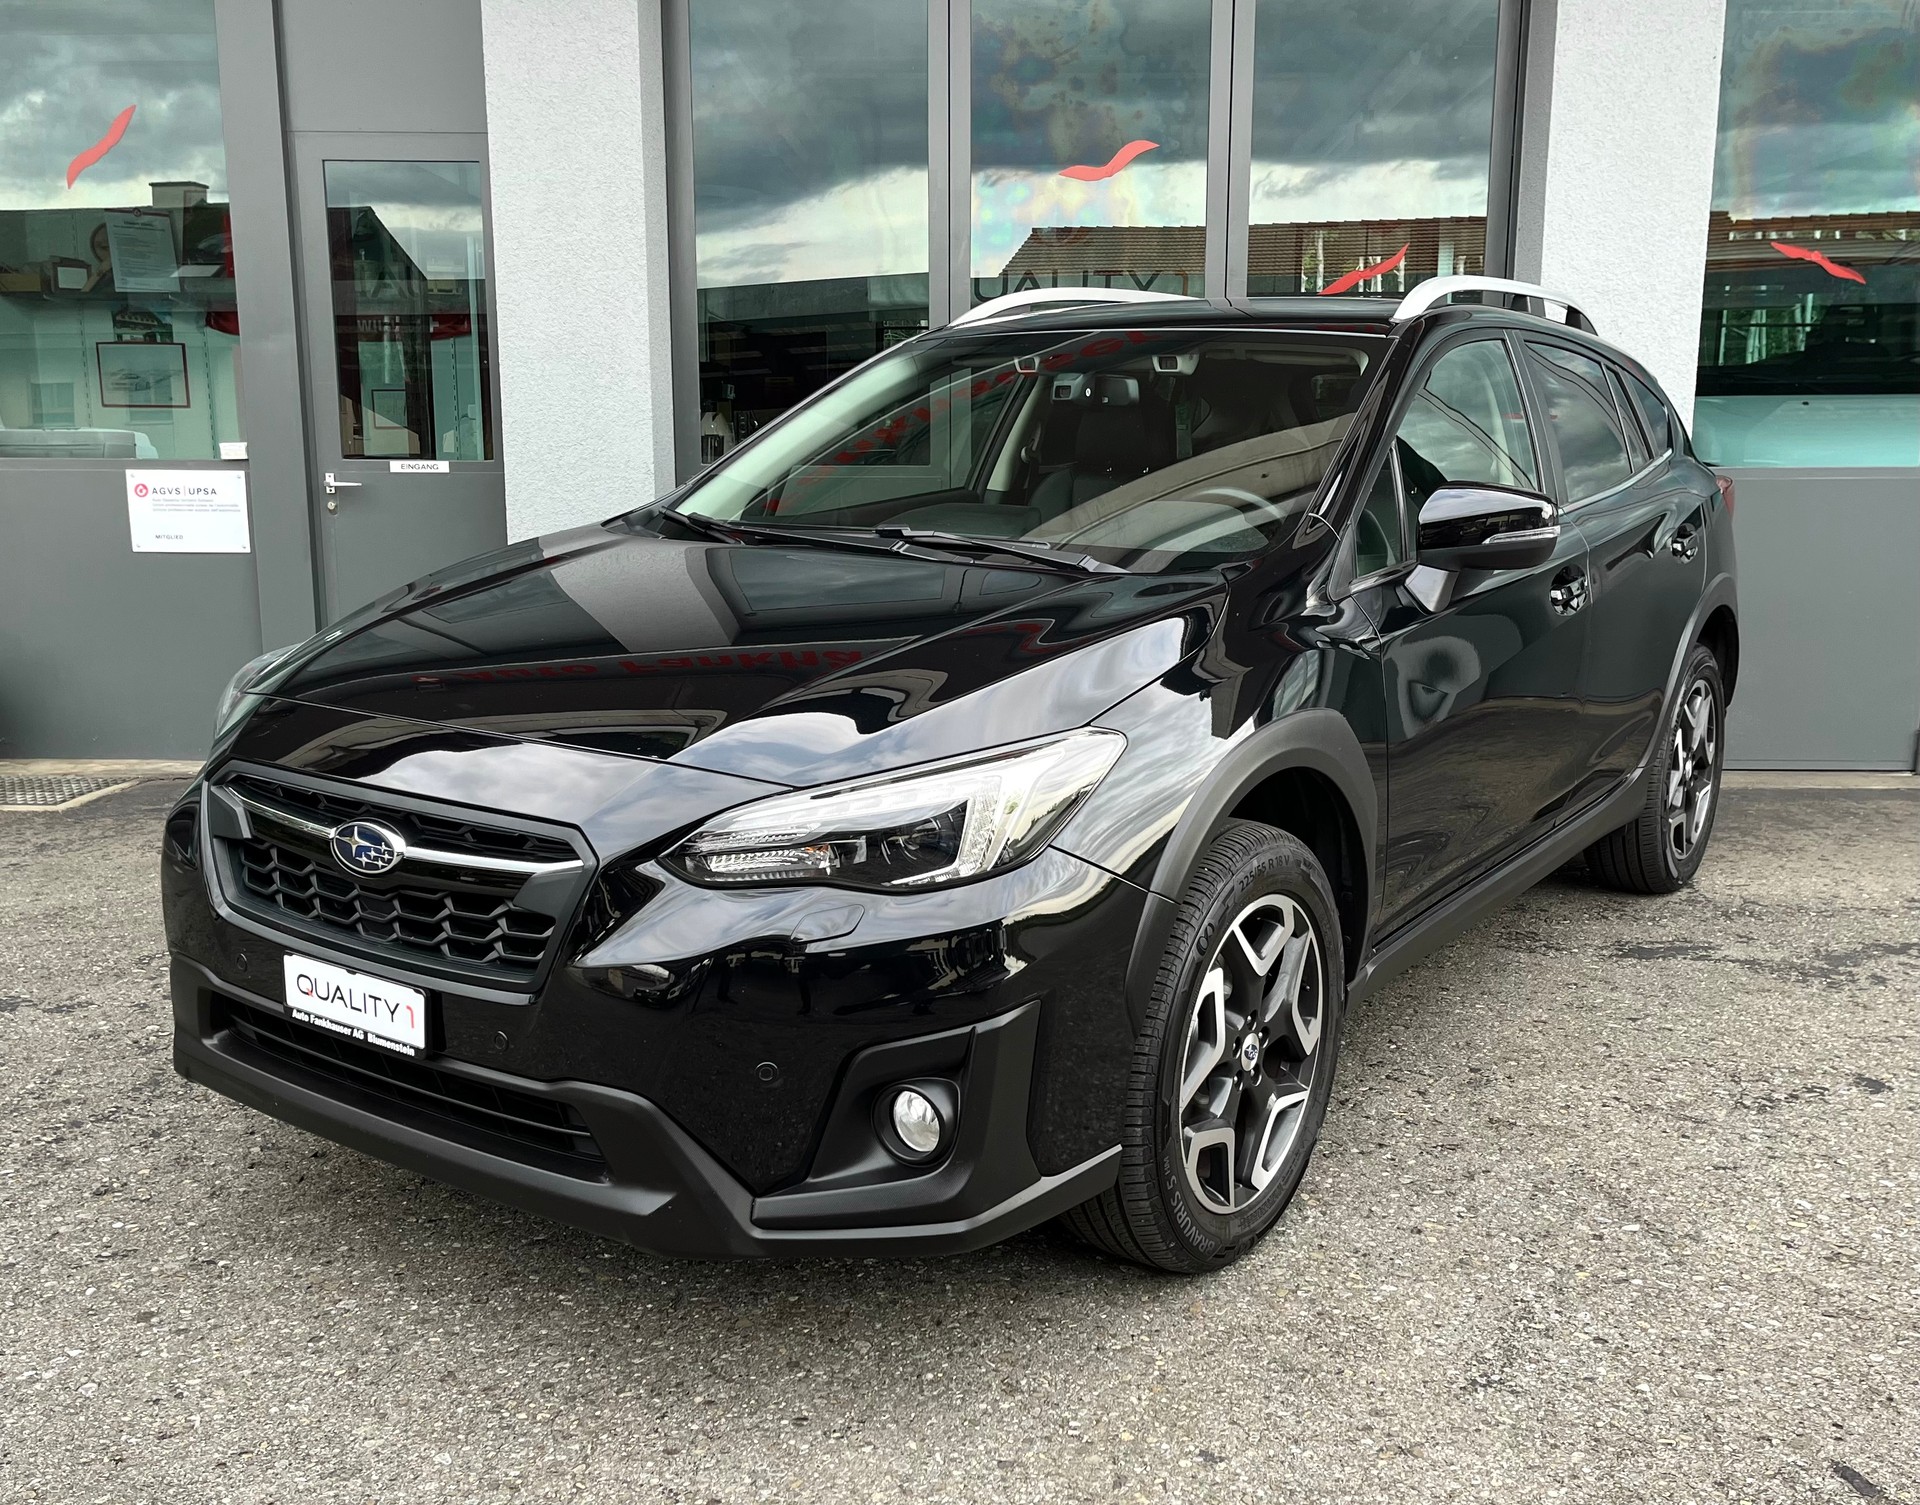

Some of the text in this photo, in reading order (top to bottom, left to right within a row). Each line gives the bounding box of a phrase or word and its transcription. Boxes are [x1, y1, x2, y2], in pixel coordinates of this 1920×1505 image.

[400, 463, 439, 471] EINGANG
[1238, 861, 1267, 893] 225/55
[291, 1008, 415, 1057] Auto Fankhauser AG Blumenstein
[1166, 1175, 1177, 1190] 5
[1171, 1191, 1215, 1255] BRAVURIS
